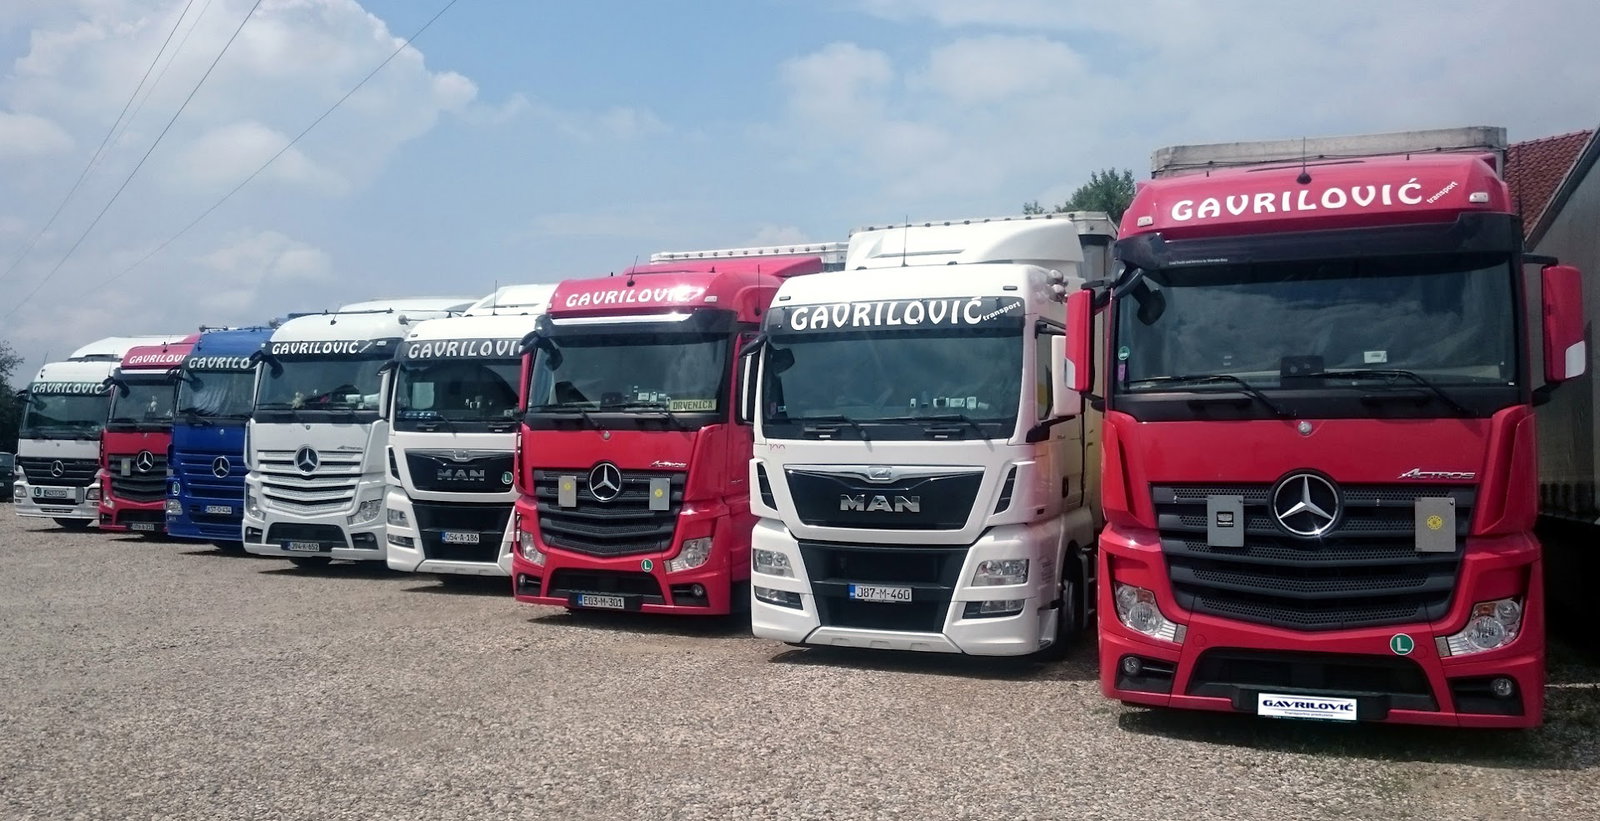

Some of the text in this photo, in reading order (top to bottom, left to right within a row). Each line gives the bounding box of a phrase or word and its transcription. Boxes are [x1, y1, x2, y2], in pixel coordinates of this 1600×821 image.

[1171, 178, 1458, 221] GAVRILOVIĆ transport
[566, 287, 690, 307] GAVRILOVI
[790, 296, 1021, 331] GAVRILOVIĆ transport
[272, 339, 359, 355] GAVRILOVIĆ
[672, 401, 713, 410] DRVENICA
[437, 469, 485, 482] MAN
[840, 494, 920, 513] MAN
[857, 587, 911, 600] J87-M-460
[1262, 700, 1354, 711] GAVRILOVIĆ
